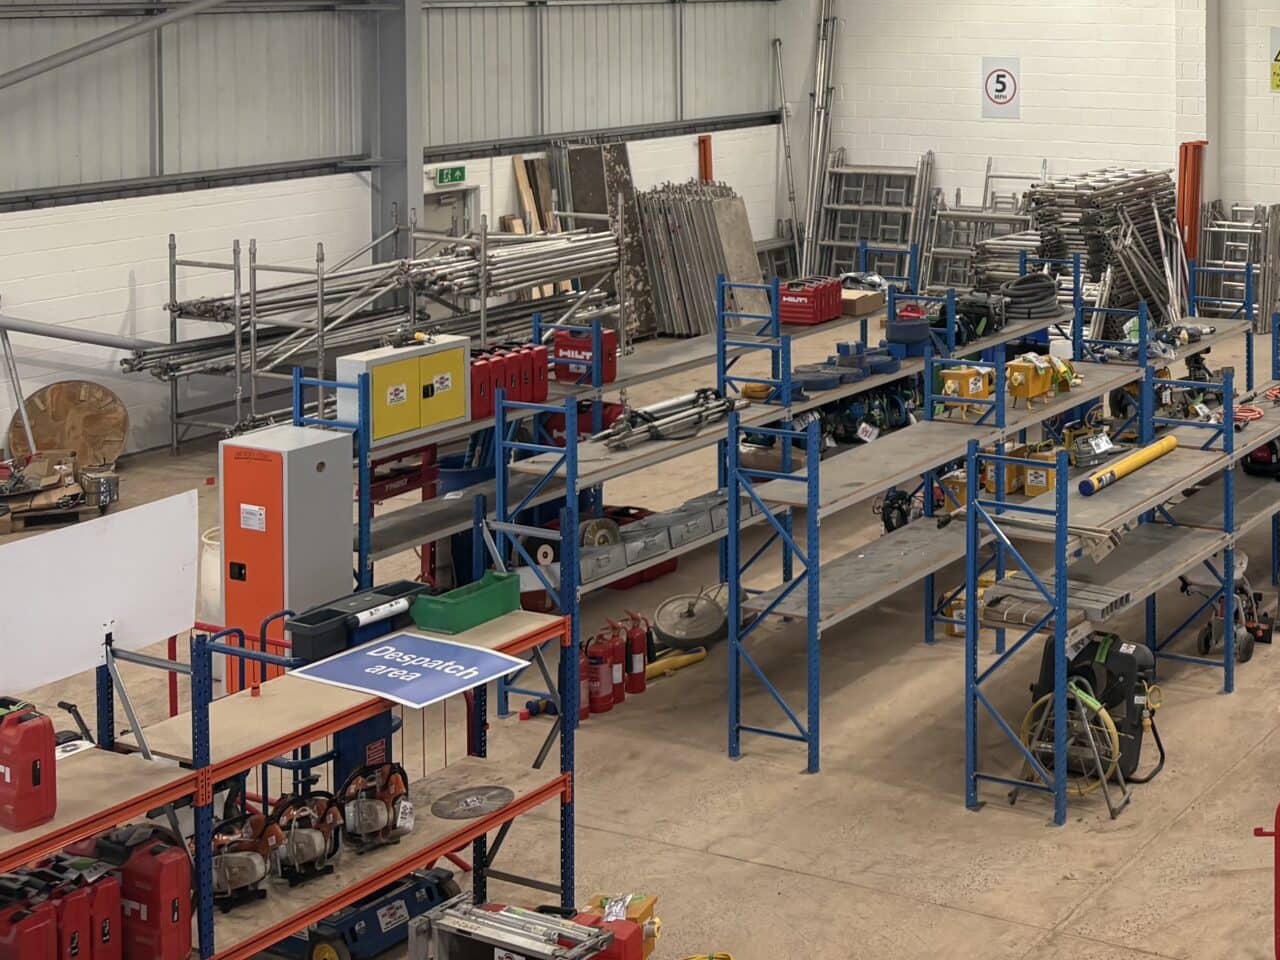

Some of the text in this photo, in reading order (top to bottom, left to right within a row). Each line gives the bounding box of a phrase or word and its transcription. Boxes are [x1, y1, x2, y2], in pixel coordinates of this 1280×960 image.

[995, 73, 1007, 93] 5
[783, 295, 808, 303] HILTI
[559, 349, 593, 360] HILT
[366, 645, 480, 680] Despatch
[364, 664, 422, 682] area
